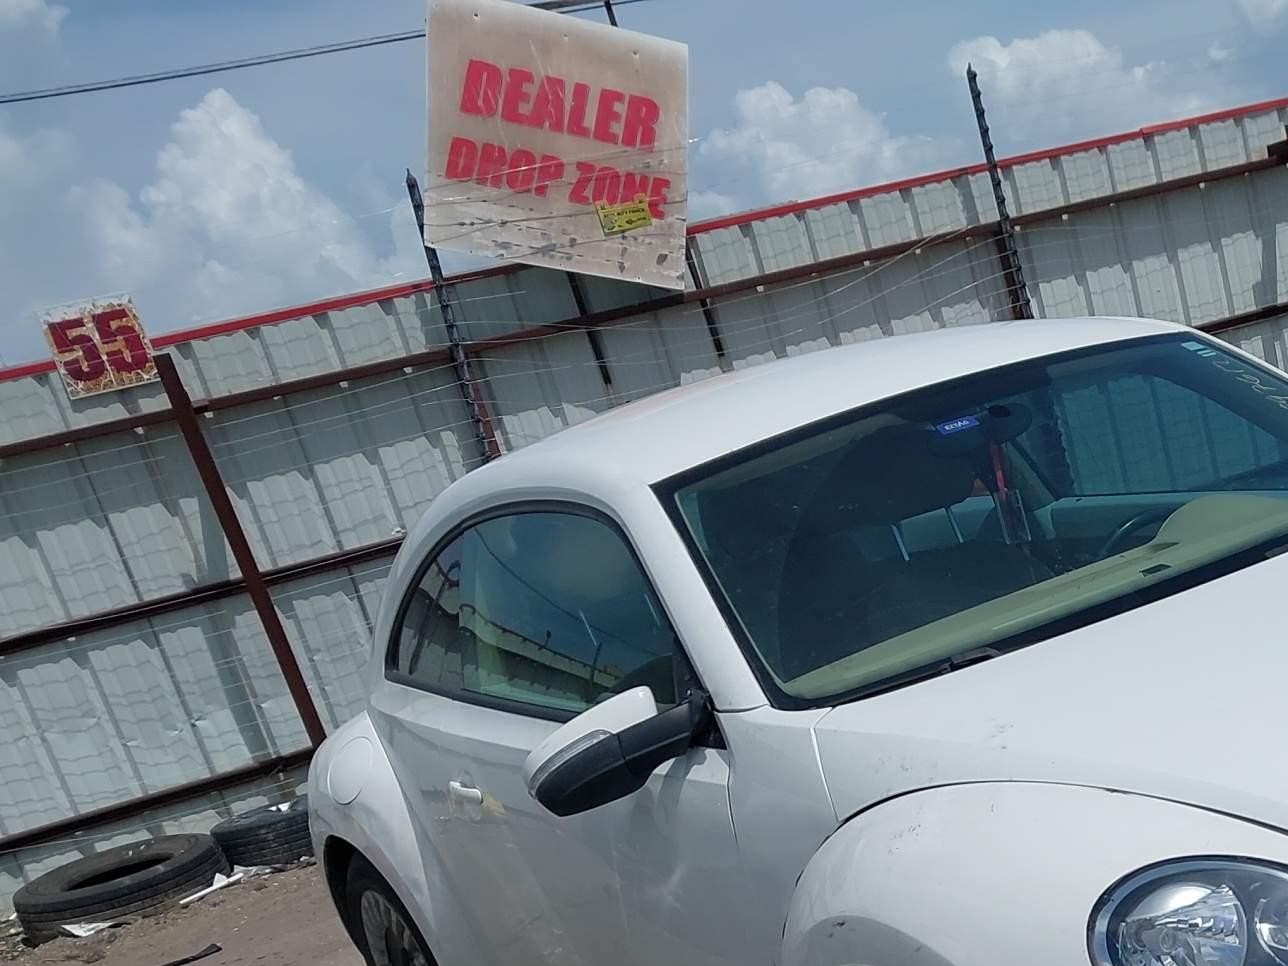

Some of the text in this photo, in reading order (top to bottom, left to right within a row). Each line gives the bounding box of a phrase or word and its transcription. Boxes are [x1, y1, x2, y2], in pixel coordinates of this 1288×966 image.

[460, 58, 661, 152] DEALER
[444, 136, 671, 219] DROP ZONE
[47, 307, 150, 381] 55
